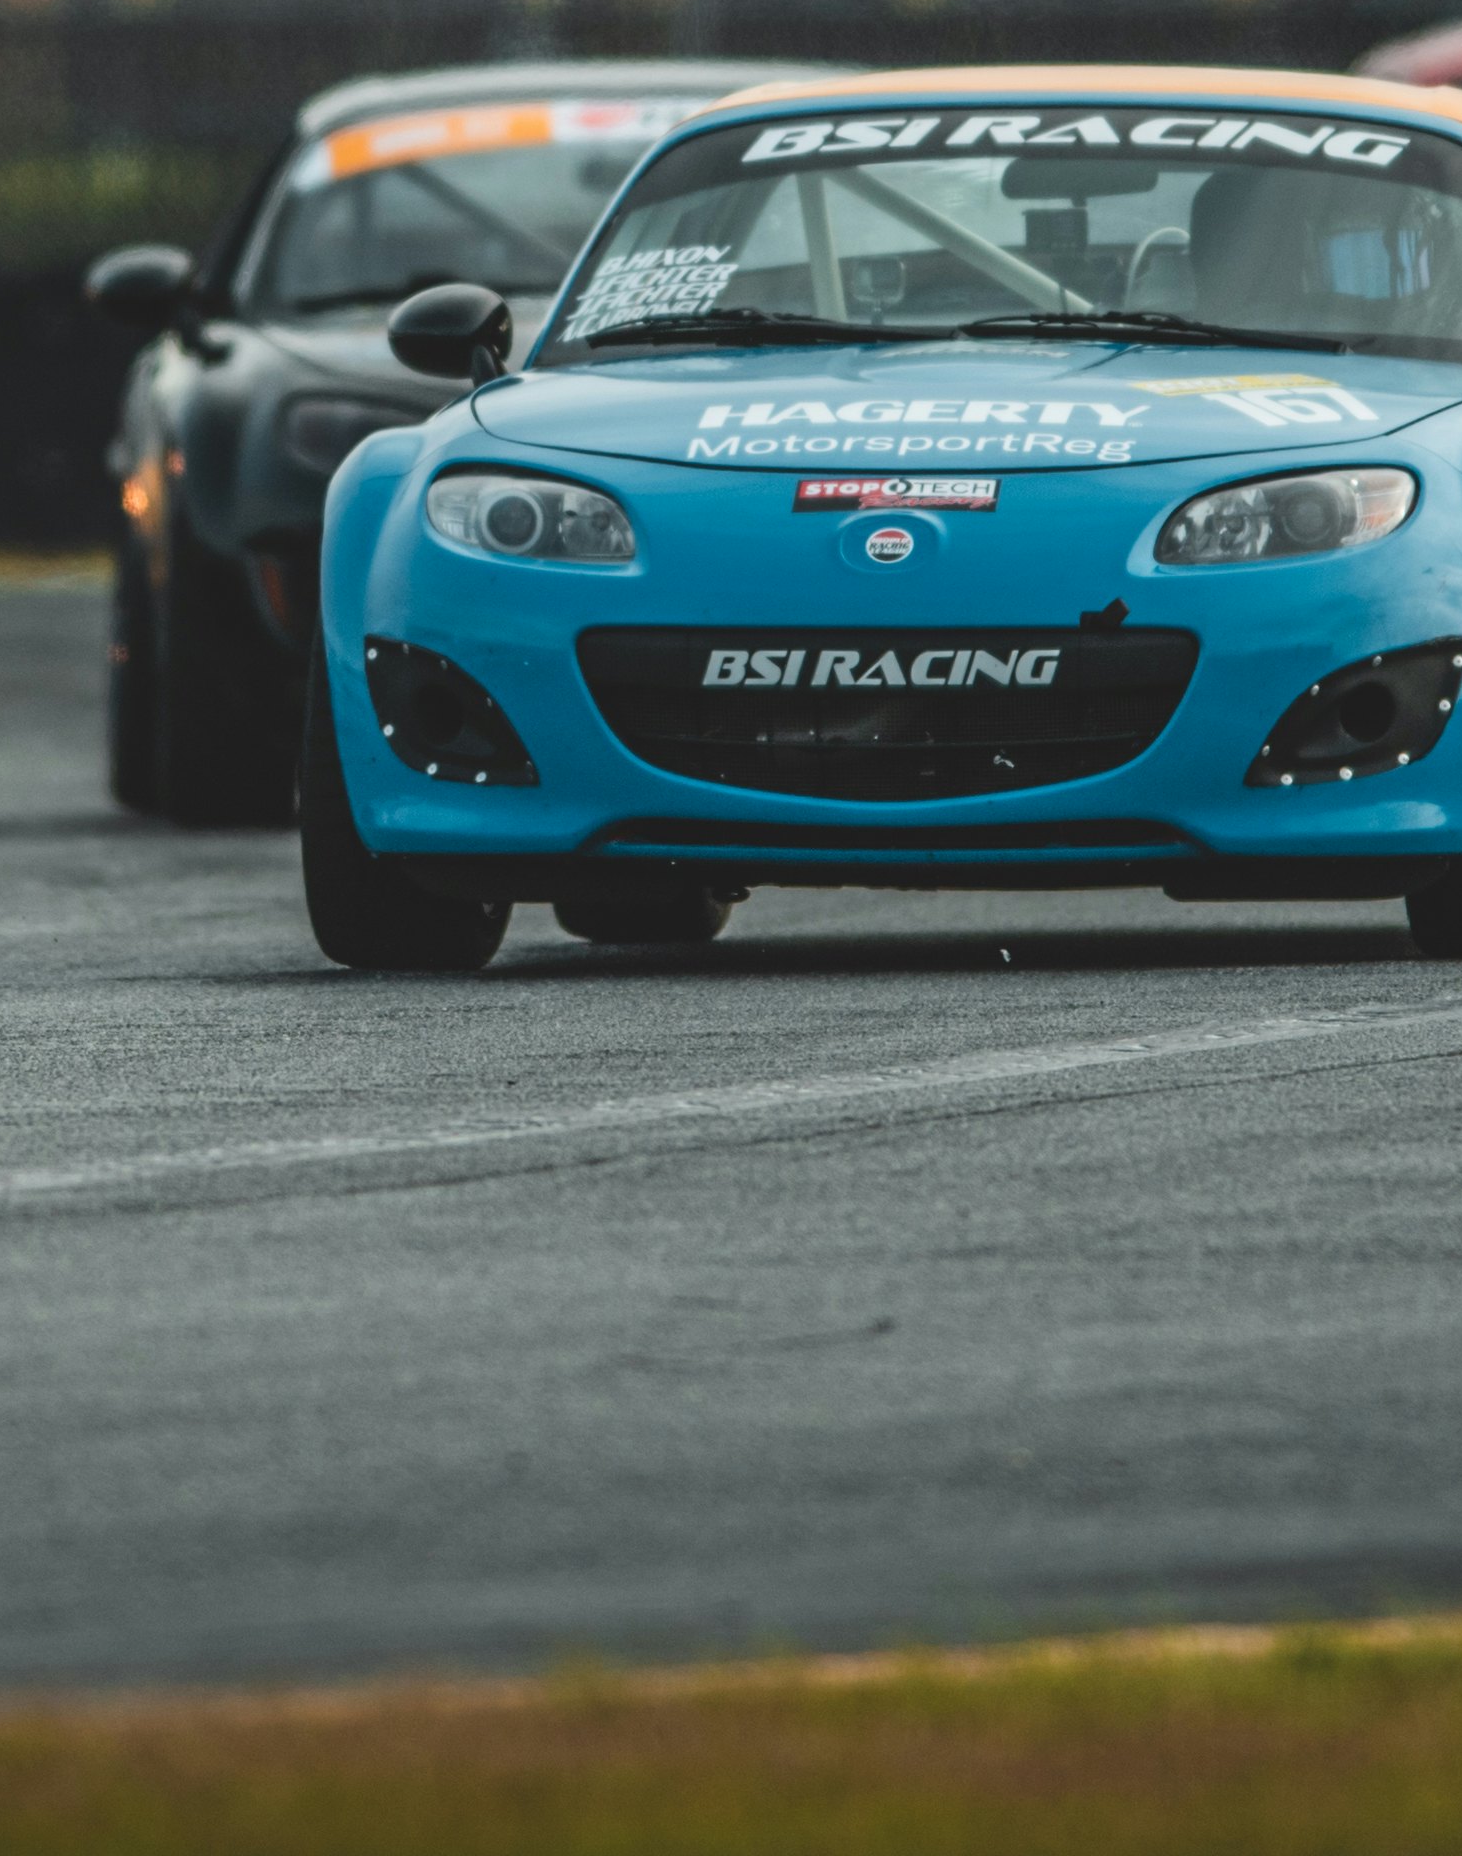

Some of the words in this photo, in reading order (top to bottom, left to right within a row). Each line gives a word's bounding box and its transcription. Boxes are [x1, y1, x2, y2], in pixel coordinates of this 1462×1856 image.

[741, 117, 940, 163] BSI
[945, 115, 1411, 167] RACING
[597, 245, 731, 278] B.HIXON
[697, 398, 1152, 430] HAGERTY
[1201, 386, 1380, 426] 167
[686, 431, 1138, 462] MotorsportReg
[702, 649, 807, 686] BSI
[810, 649, 1061, 686] RACING
